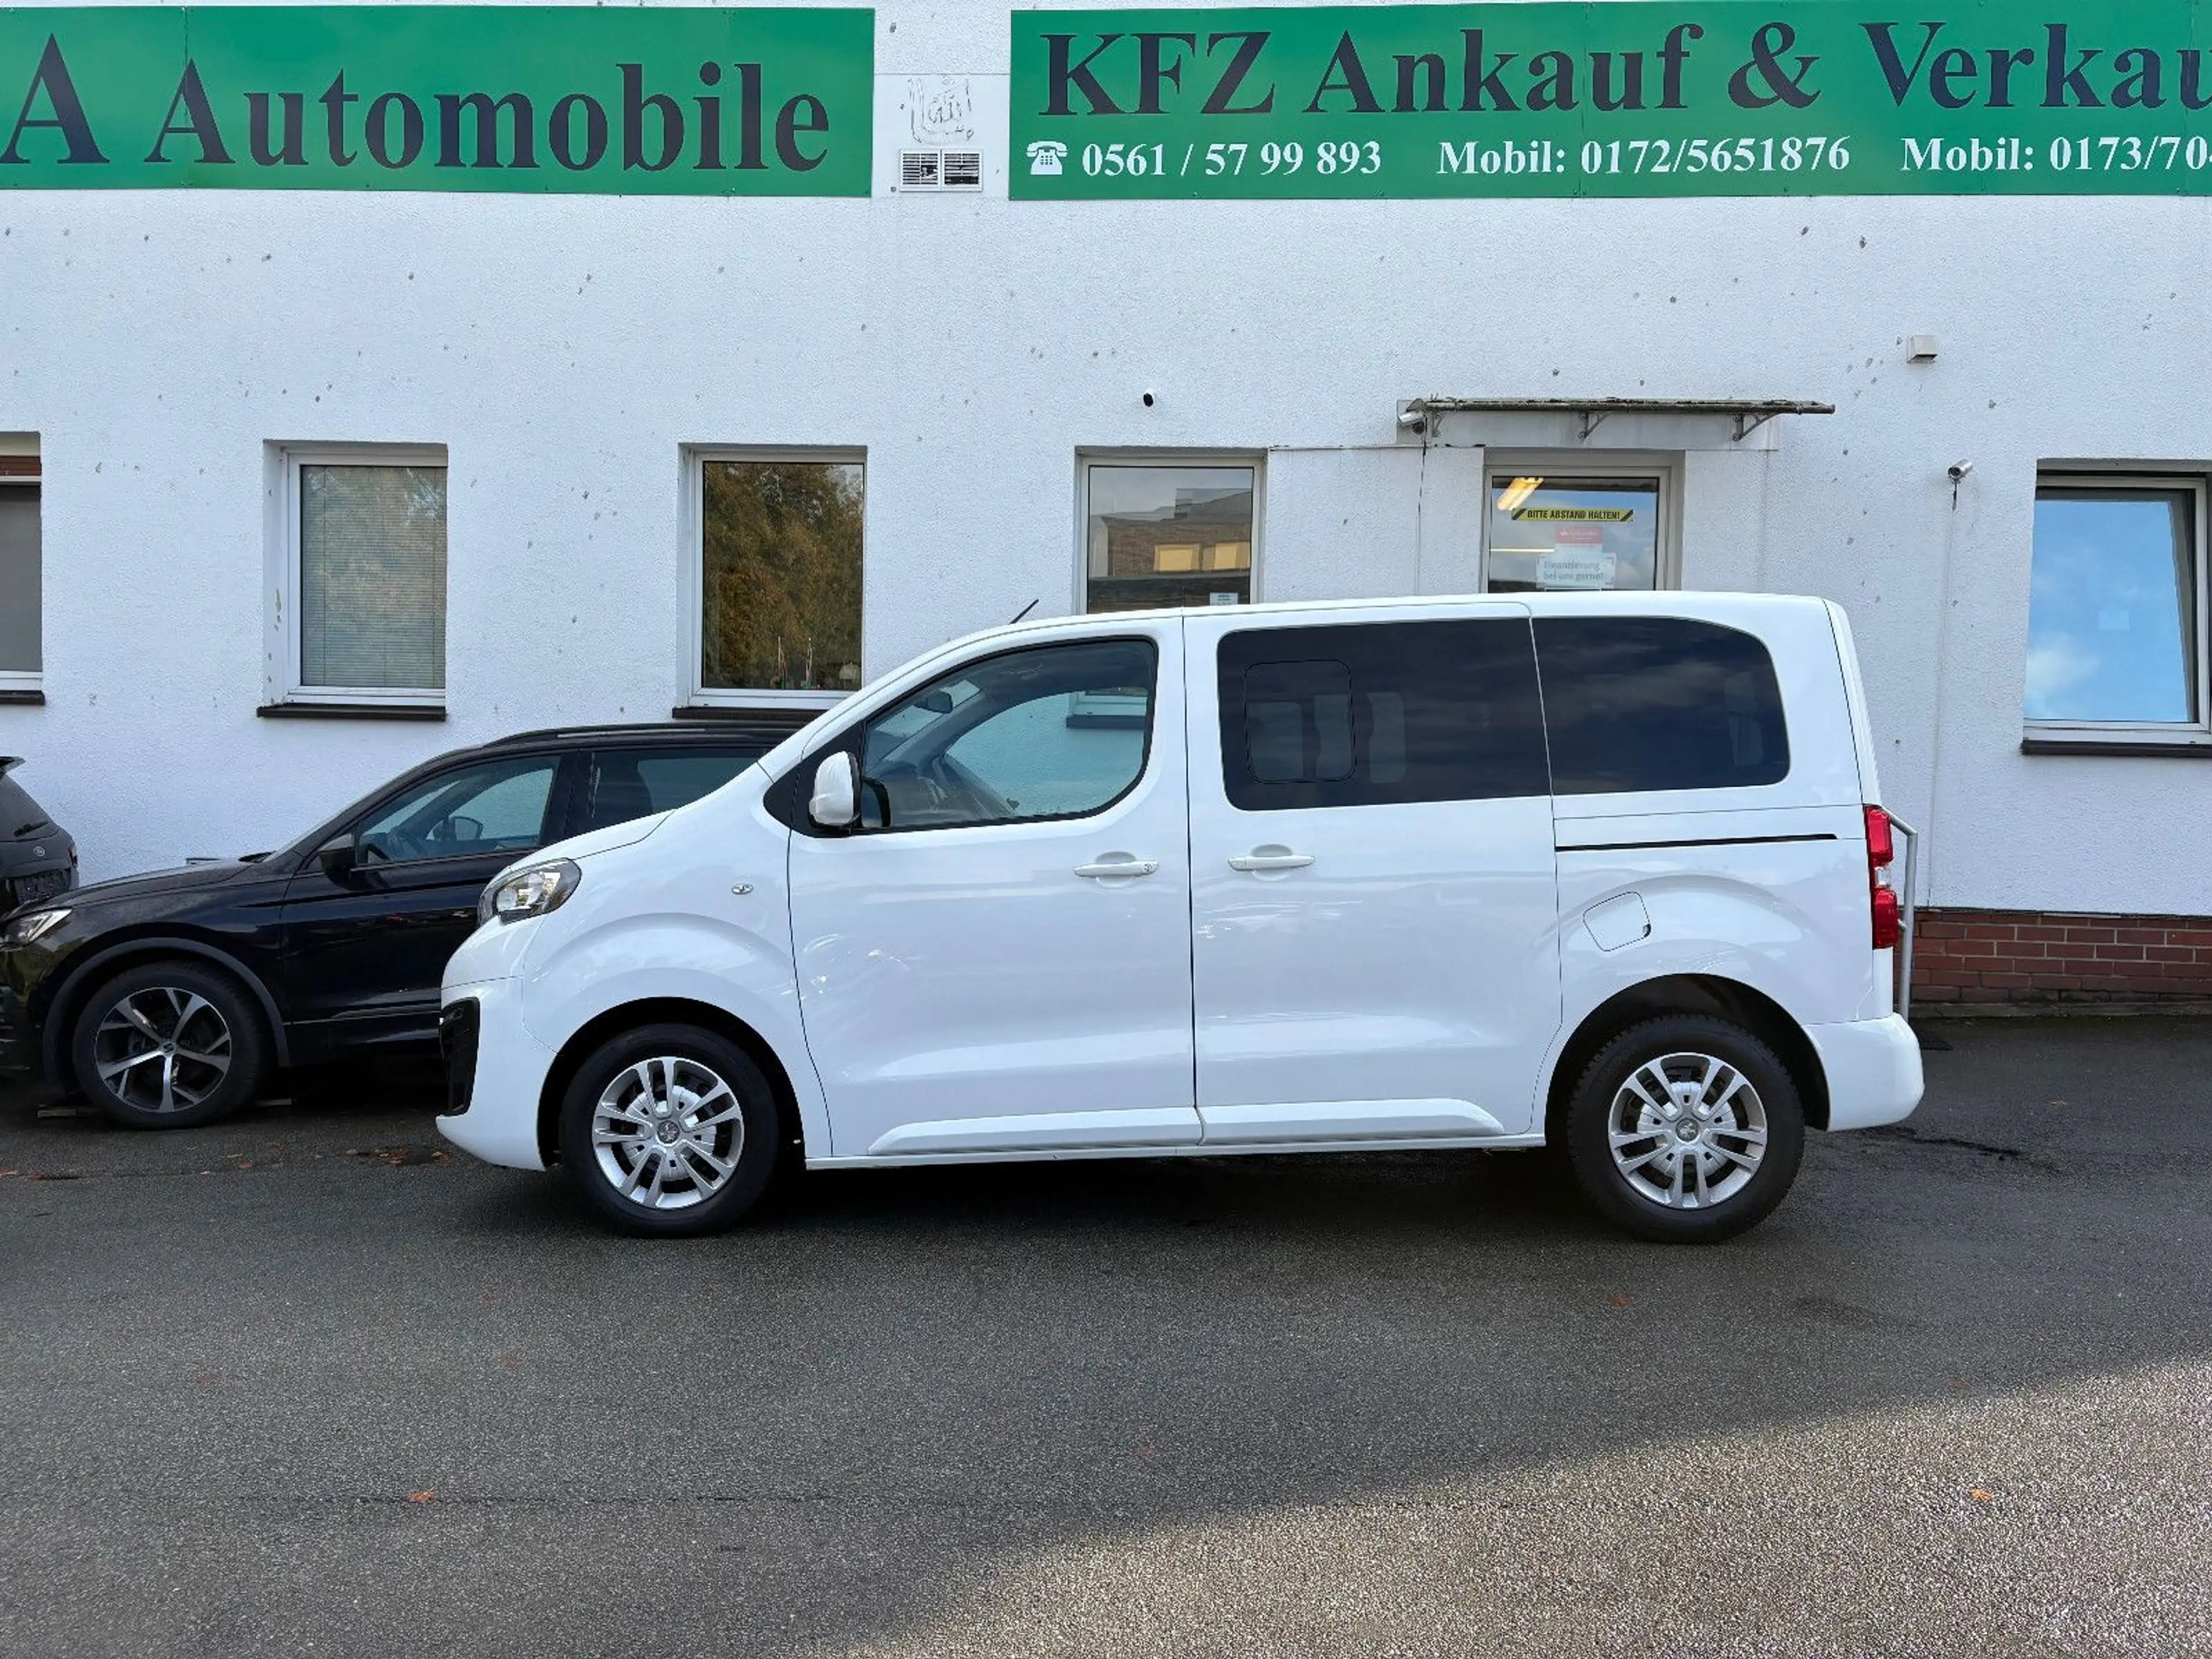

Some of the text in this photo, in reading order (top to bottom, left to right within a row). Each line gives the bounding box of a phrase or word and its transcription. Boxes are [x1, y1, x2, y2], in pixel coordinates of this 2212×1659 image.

[0, 33, 829, 172] A Automobile
[1039, 31, 1275, 116] KFZ
[1301, 24, 1704, 113] Ankauf
[1728, 22, 1821, 108] &
[1082, 143, 1166, 176] 0561
[1206, 143, 1248, 175] 57
[1260, 142, 1303, 175] 99
[1317, 141, 1381, 174] 893
[1437, 140, 1565, 174] Mobil:
[1581, 135, 1851, 173] 0172/5651876
[1900, 137, 2033, 171] Mobil:
[2050, 135, 2212, 171] 0173/70
[1528, 510, 1620, 520] BITTE ABSTAND HALTEN!
